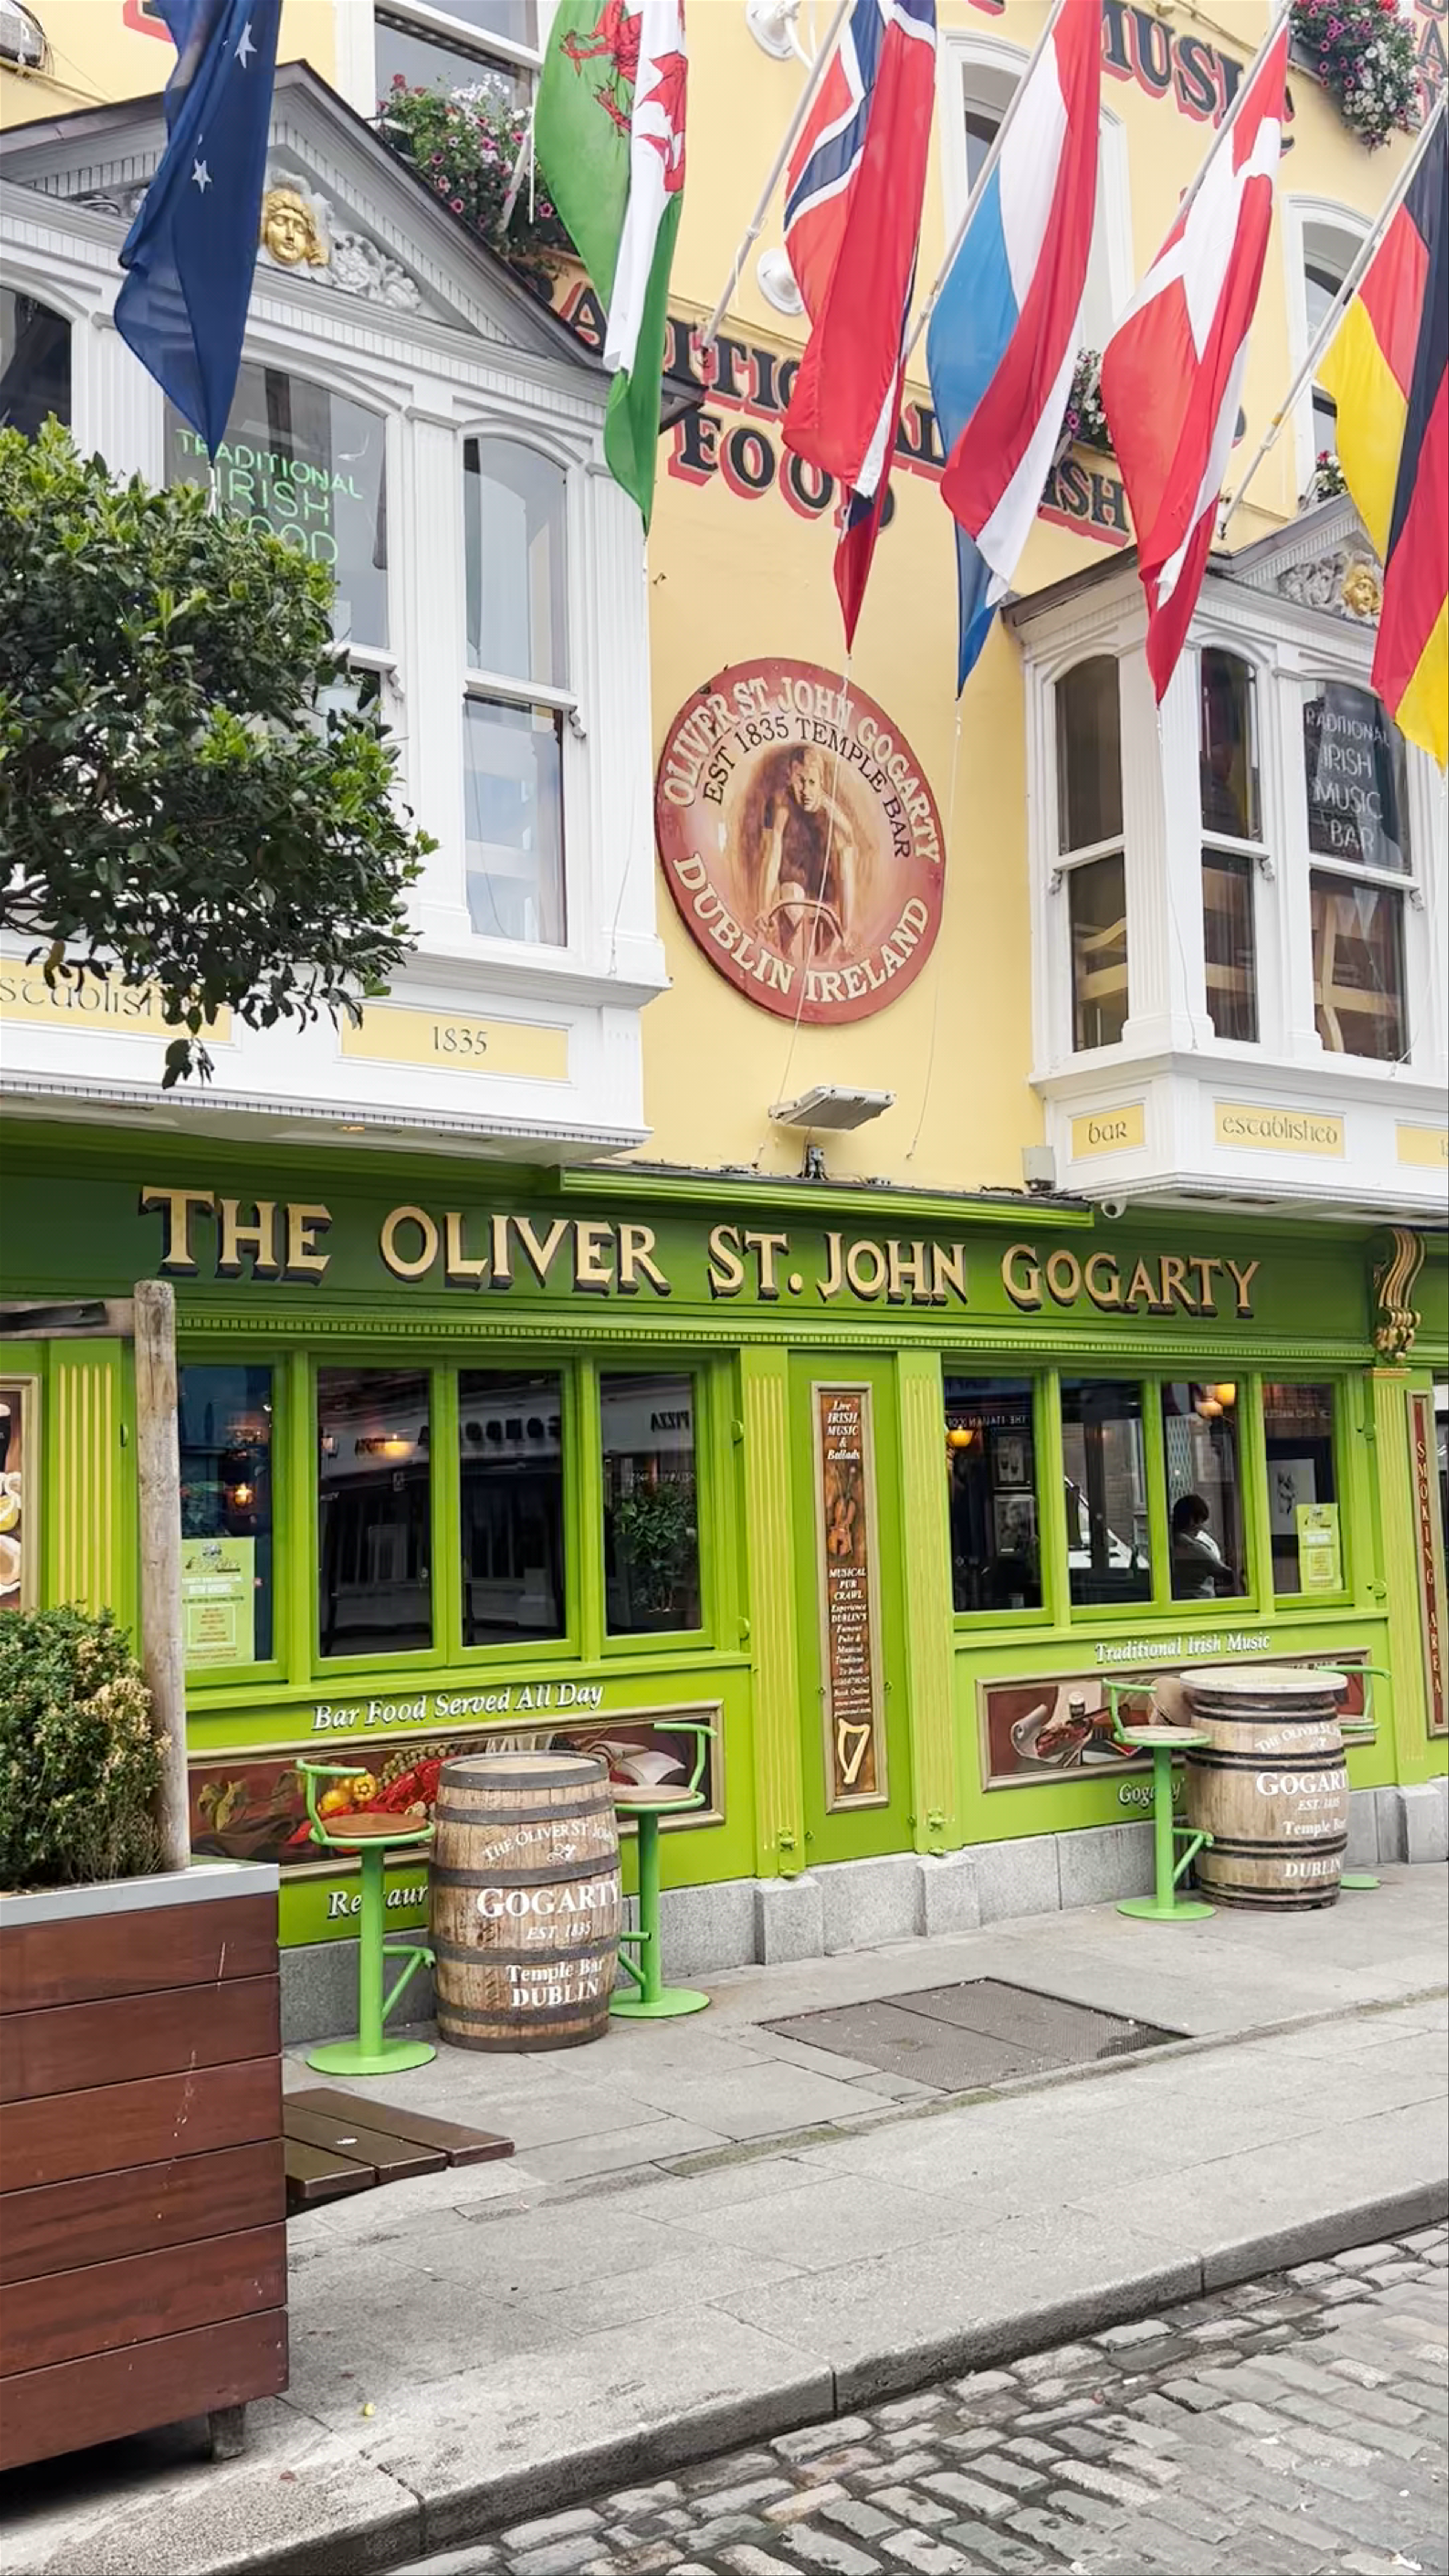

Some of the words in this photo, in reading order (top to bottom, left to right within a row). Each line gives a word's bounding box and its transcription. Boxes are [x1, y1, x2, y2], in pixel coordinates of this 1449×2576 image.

[176, 428, 363, 499] TRADITIONAL
[669, 409, 895, 528] FOO
[663, 693, 738, 807] OLIVER
[733, 677, 769, 715] ST
[777, 677, 854, 728] JOHN
[857, 717, 940, 863] GOGARTY
[1323, 744, 1372, 778] IRISH
[703, 746, 737, 804] EST
[735, 715, 789, 754] 1835
[796, 718, 886, 793] TEMPLE
[883, 798, 911, 858] BAR
[1314, 780, 1383, 820] MUSIC
[1330, 819, 1374, 852] BAR
[672, 853, 797, 995] DUBLIN
[805, 898, 928, 1003] IRELAND
[434, 1026, 488, 1055] 1835
[139, 1185, 333, 1285] THE
[380, 1205, 672, 1297] OLIVER
[708, 1224, 804, 1301] ST.
[817, 1230, 968, 1306] JOHN
[1001, 1243, 1260, 1318] GOGARTY
[827, 1412, 858, 1423] IRISH
[827, 1426, 858, 1436] MUSIC
[827, 1449, 860, 1460] Ballads
[1417, 1441, 1433, 1584] SMOKING
[829, 1567, 866, 1578] MUSICAL
[834, 1590, 864, 1601] CRAWL
[1096, 1636, 1181, 1664] Traditional
[1187, 1633, 1221, 1656] Irish
[1226, 1632, 1270, 1653] Music
[312, 1705, 359, 1730] Bar
[365, 1695, 427, 1727] Food
[434, 1689, 510, 1720] Served
[516, 1684, 551, 1710] All
[557, 1682, 604, 1710] Day
[483, 1839, 514, 1861] THE
[516, 1824, 569, 1846] OLIVER
[571, 1820, 589, 1836] ST
[1284, 1855, 1341, 1878] DUBLIN
[477, 1880, 618, 1918] GOGARTY
[566, 1920, 592, 1937] 1835
[506, 1962, 574, 1984] Temple
[578, 1957, 604, 1976] Bar
[511, 1978, 599, 2007] DUBLIN
